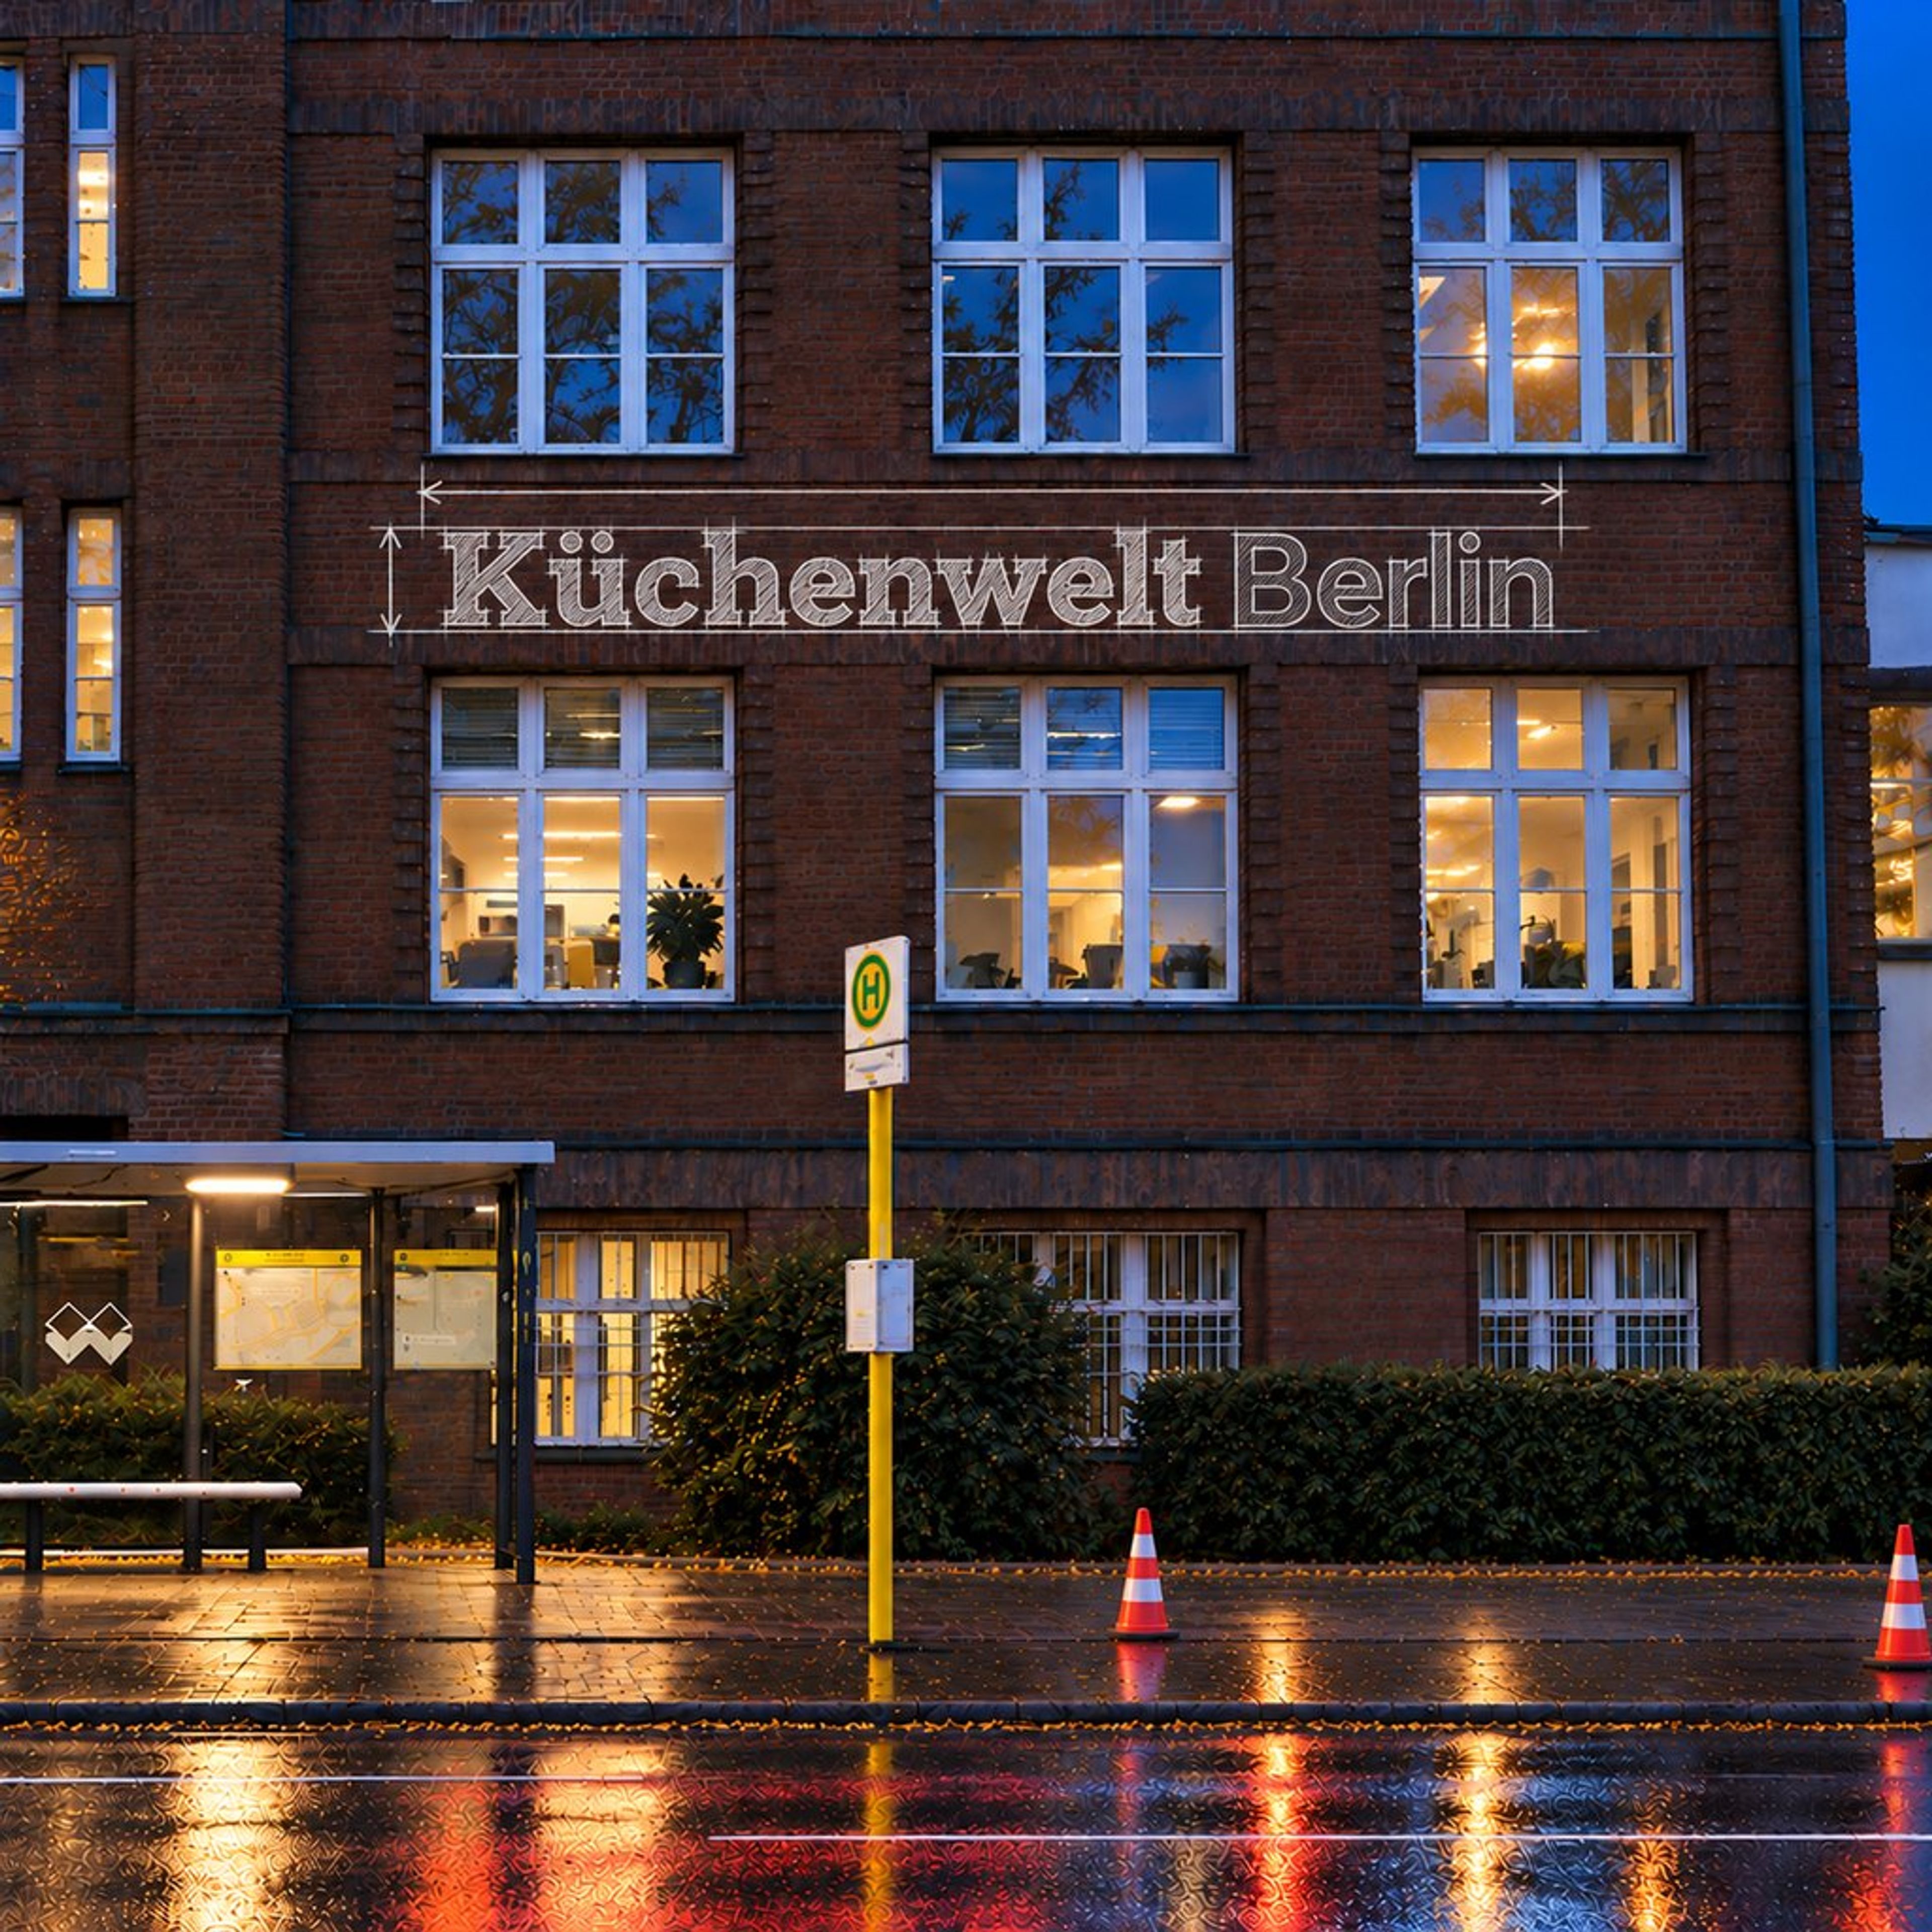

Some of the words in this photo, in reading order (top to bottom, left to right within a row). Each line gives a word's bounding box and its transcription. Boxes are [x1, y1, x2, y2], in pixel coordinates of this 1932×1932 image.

[441, 527, 1201, 627] Küchenwelt
[1233, 529, 1555, 628] Berlin
[862, 971, 880, 1011] H
